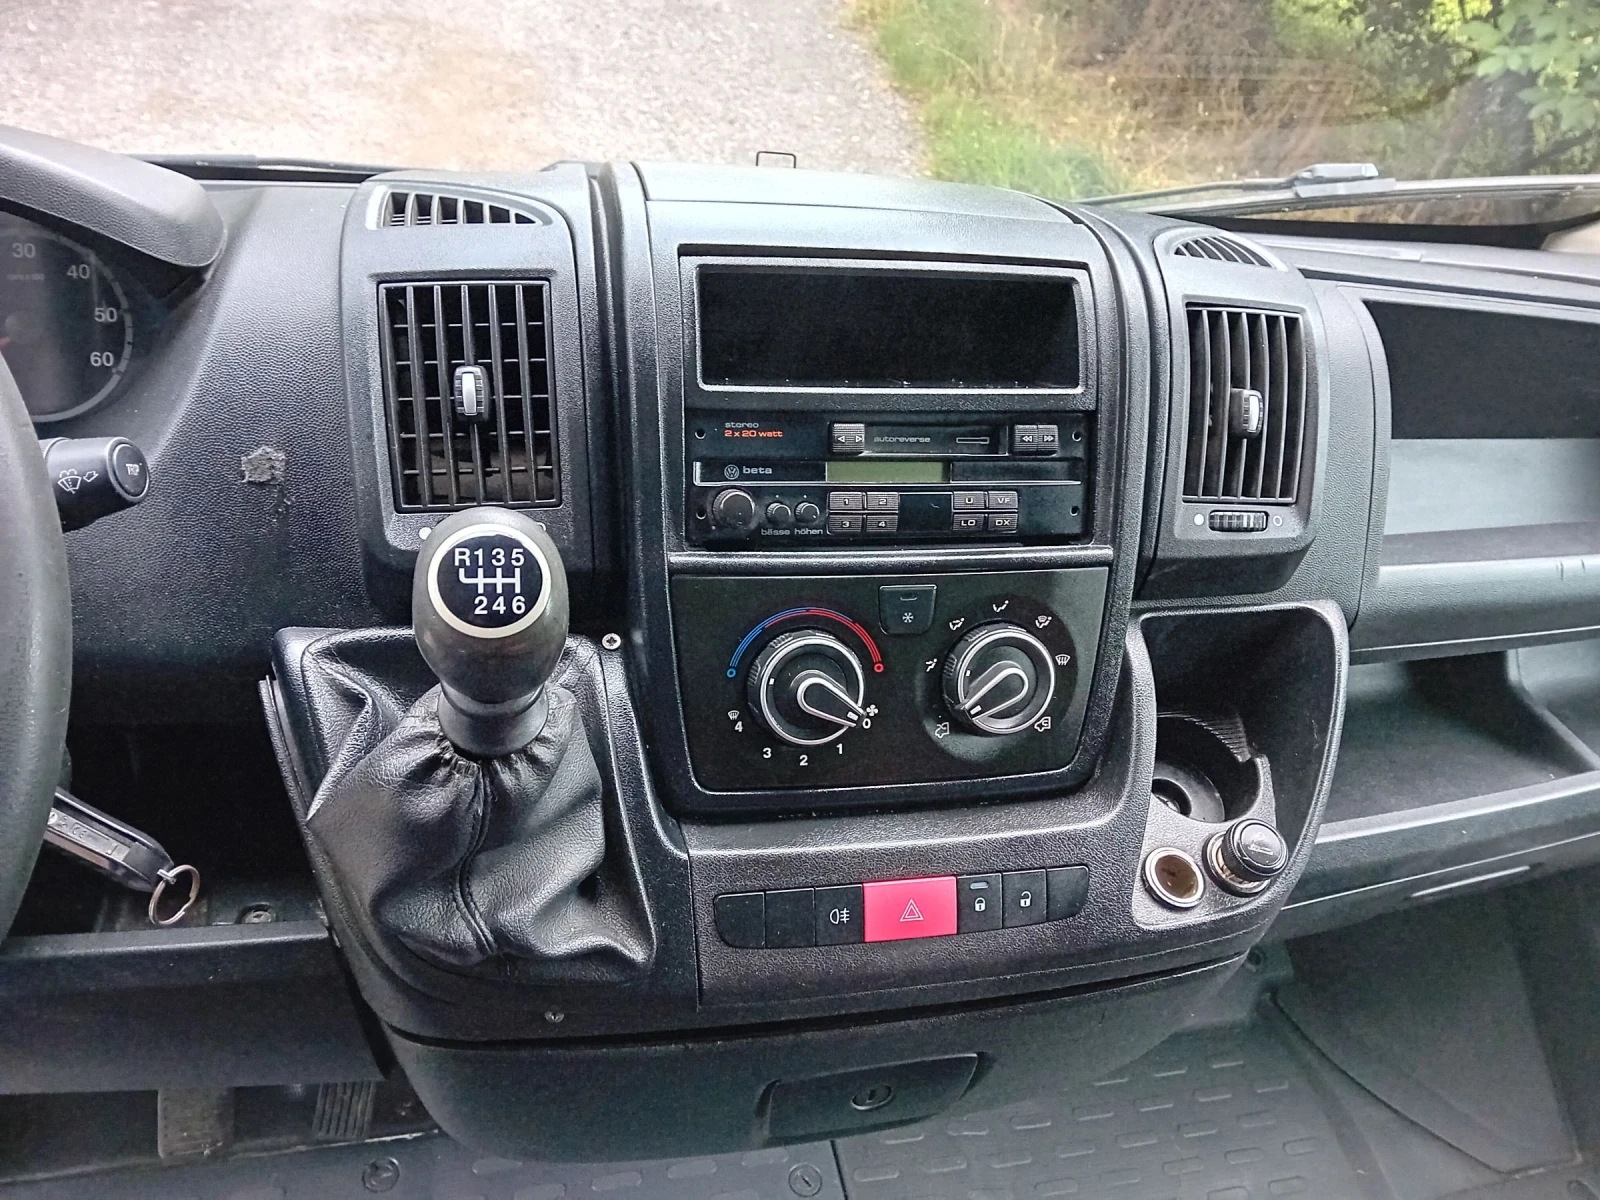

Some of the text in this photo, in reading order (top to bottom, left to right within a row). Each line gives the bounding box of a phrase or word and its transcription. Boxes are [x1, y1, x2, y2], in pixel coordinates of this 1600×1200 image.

[11, 242, 36, 259] 30
[66, 264, 90, 279] 40
[94, 307, 117, 323] 50
[90, 351, 114, 367] 60
[724, 429, 732, 437] 2
[741, 429, 757, 438] 20
[758, 430, 783, 438] watt
[742, 465, 773, 475] beta
[842, 520, 850, 528] 3
[877, 520, 887, 528] 4
[995, 519, 1011, 527] DX
[454, 547, 525, 567] R 1 3 5
[473, 595, 526, 615] 2 4 6
[734, 721, 744, 733] 4
[862, 719, 872, 729] 0
[762, 747, 773, 759] 3
[836, 743, 844, 754] 1
[799, 754, 809, 766] 2
